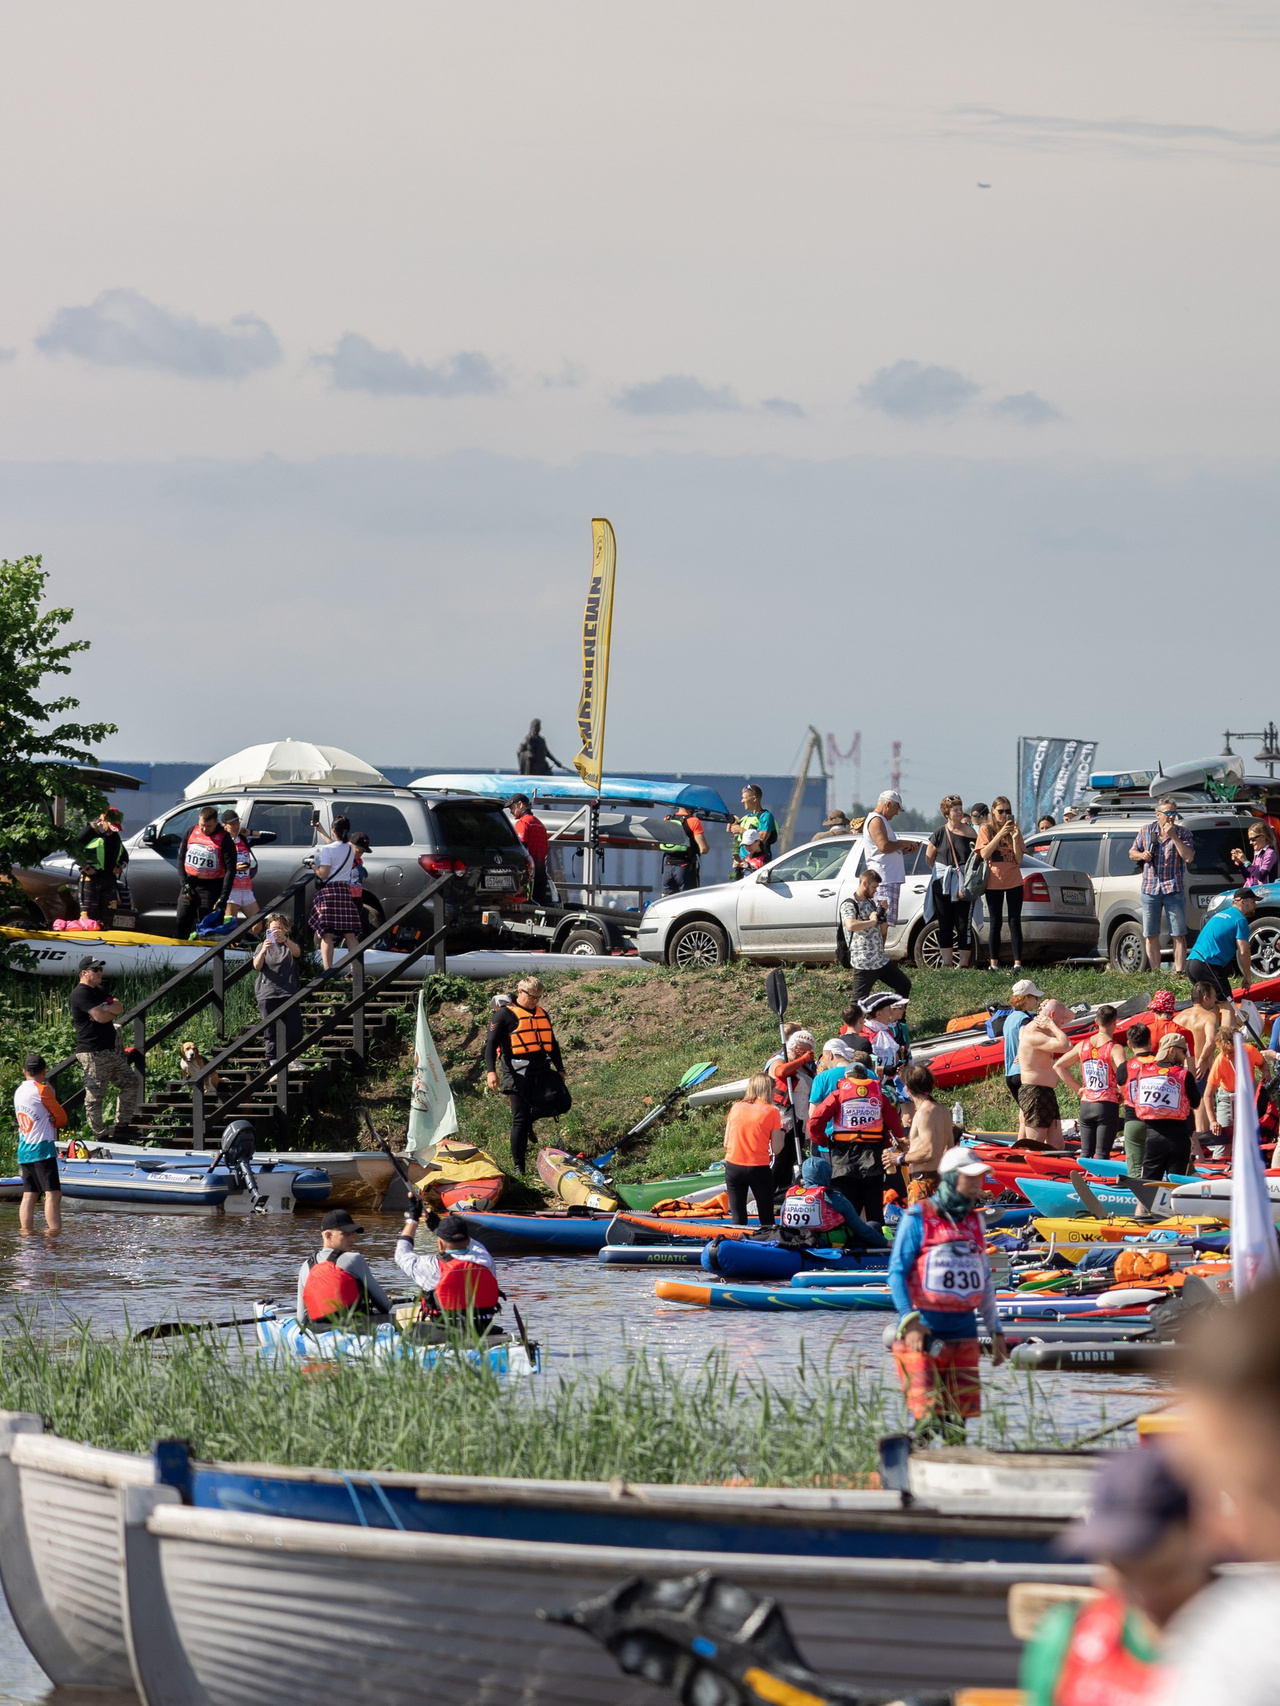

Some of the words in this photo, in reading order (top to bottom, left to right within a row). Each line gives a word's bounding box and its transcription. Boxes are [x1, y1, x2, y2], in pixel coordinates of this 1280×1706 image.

[187, 854, 214, 868] 1078
[1143, 1090, 1172, 1105] 794
[845, 1109, 879, 1118] МАРАФОН
[786, 1213, 811, 1225] 999
[646, 1253, 688, 1262] AQUATIC
[943, 1270, 981, 1290] 830
[1070, 1350, 1115, 1362] TANDEM
